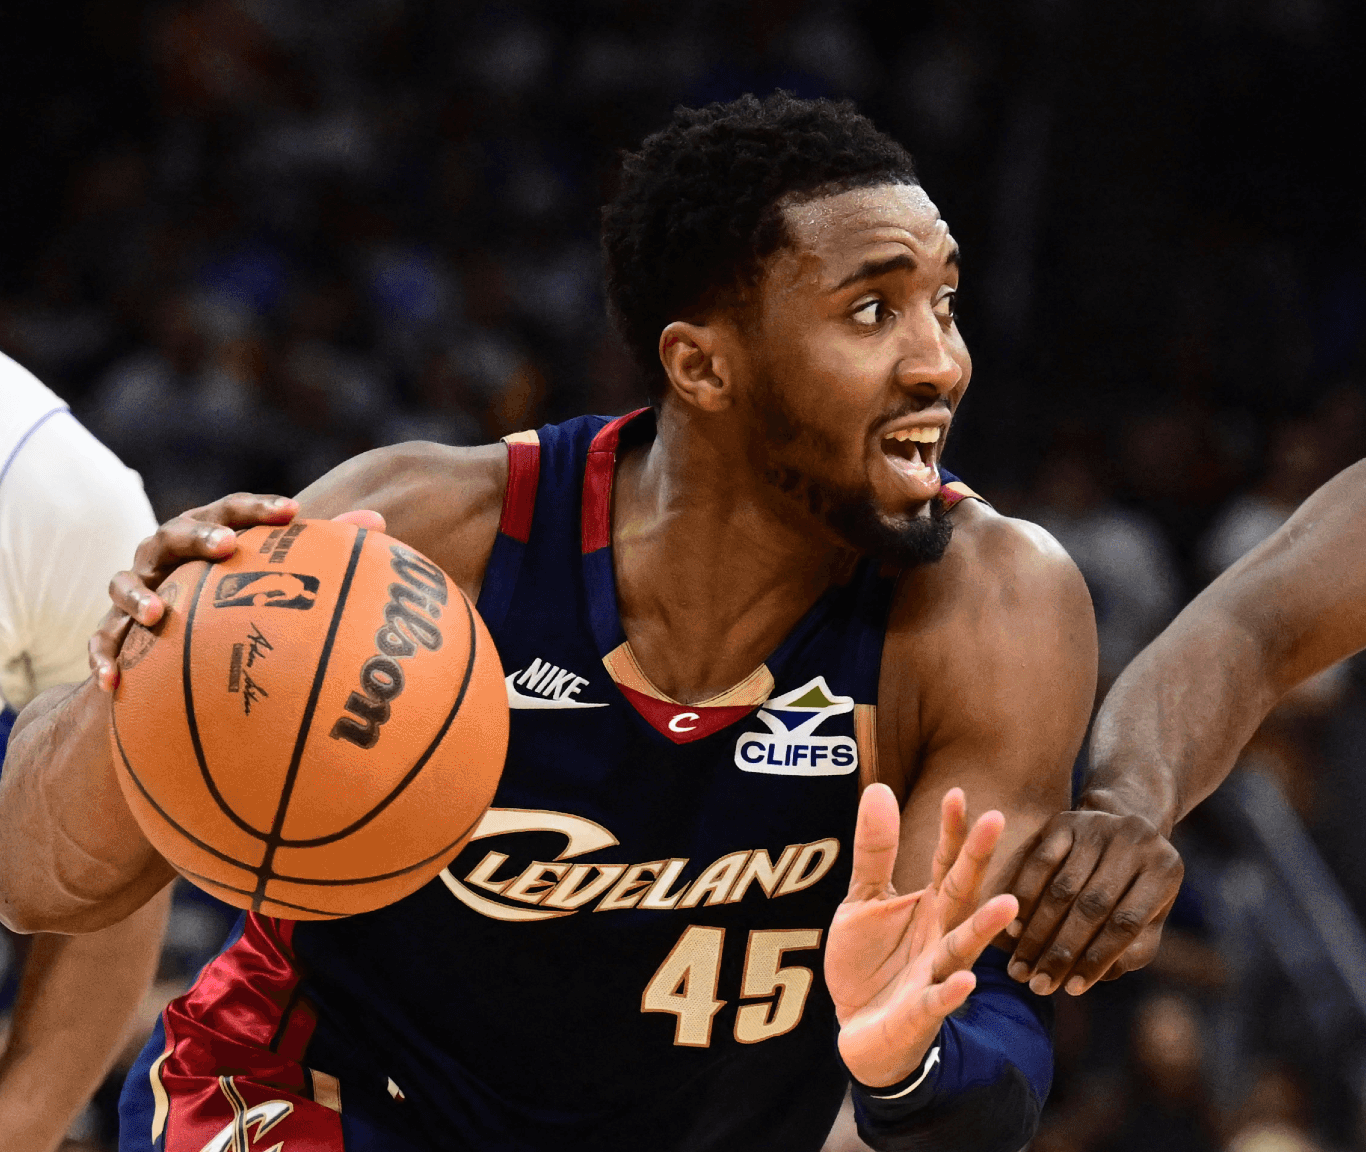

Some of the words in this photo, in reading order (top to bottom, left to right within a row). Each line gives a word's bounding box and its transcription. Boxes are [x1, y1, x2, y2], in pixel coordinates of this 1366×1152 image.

[329, 543, 449, 750] Wilson
[516, 657, 591, 702] NIKE
[740, 741, 855, 767] CLIFFS
[439, 806, 841, 922] CLEVELAND
[640, 924, 824, 1048] 45
